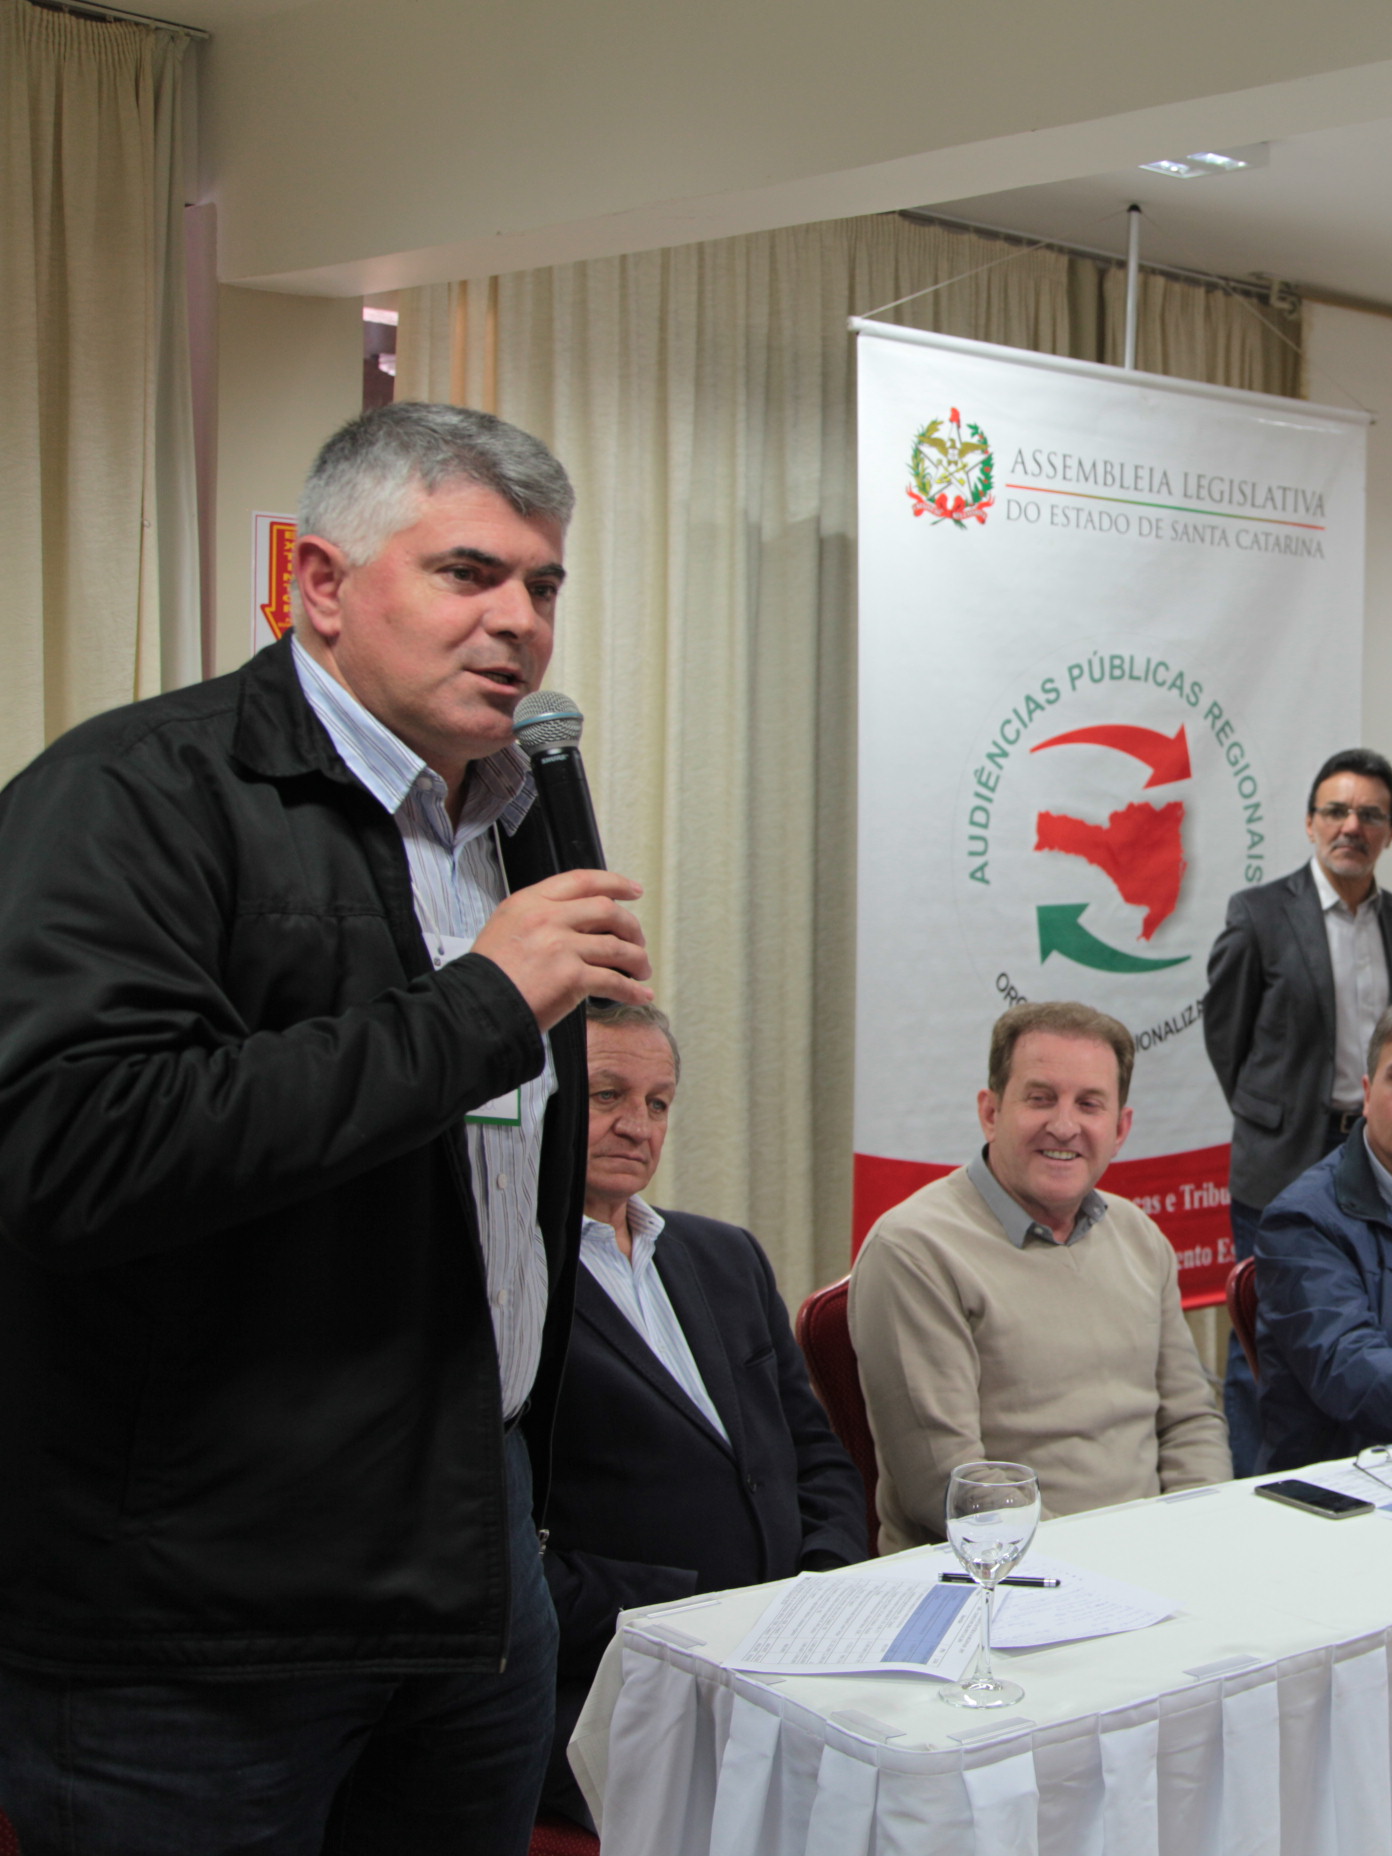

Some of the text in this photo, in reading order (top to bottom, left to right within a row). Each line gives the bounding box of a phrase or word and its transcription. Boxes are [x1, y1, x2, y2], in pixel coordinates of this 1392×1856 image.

[1010, 447, 1326, 518] ASSEMBLEIA LEGISLATIVA
[1005, 498, 1042, 524] DO
[1049, 503, 1131, 536] ESTADO
[1138, 515, 1164, 540] DE
[1170, 519, 1230, 549] SANTA
[1235, 527, 1326, 560] CATARINA
[967, 650, 1266, 886] AUDIÊNCIAS PÚBLICAS REGIONAIS
[1135, 999, 1205, 1053] IONALIZA
[1165, 1192, 1177, 1213] e
